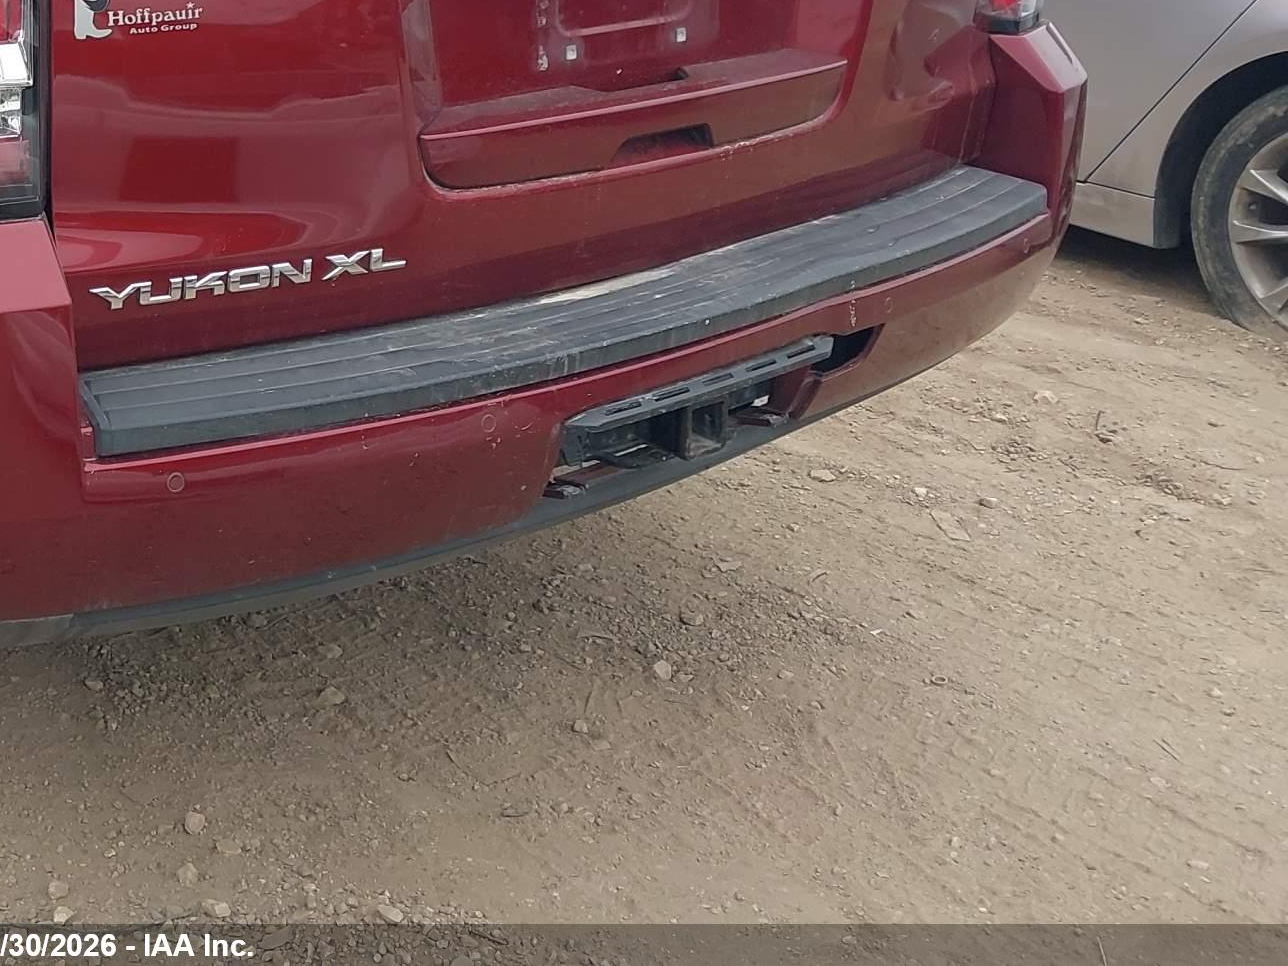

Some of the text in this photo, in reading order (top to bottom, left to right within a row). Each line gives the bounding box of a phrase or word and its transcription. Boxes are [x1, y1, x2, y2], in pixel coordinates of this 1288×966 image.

[107, 2, 203, 26] Hoffpauir
[129, 22, 198, 35] Auto Group
[88, 248, 407, 310] YUKON XL
